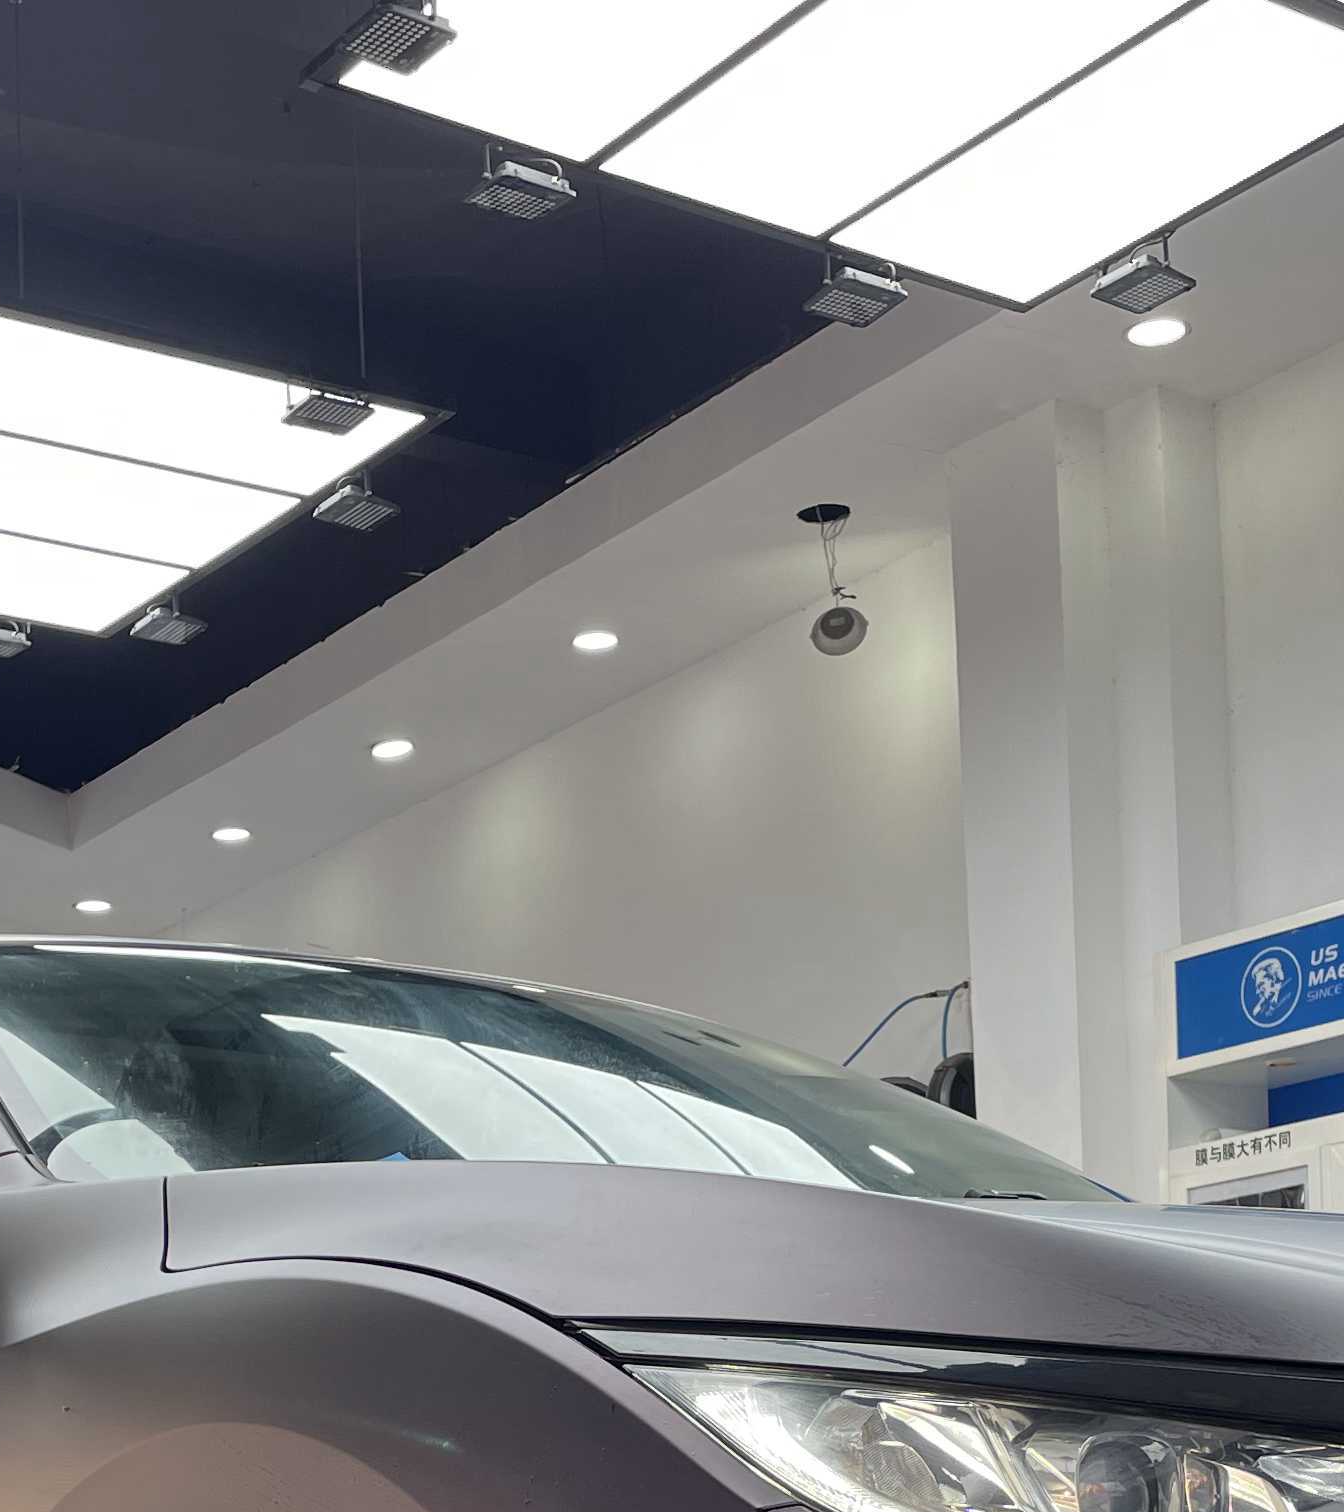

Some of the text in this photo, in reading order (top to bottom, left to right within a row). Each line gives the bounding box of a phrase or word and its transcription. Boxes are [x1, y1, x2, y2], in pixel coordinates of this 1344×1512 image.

[1310, 943, 1339, 966] US
[1306, 982, 1344, 1002] SINCE
[1195, 1131, 1292, 1167] 膜与膜大有不同
